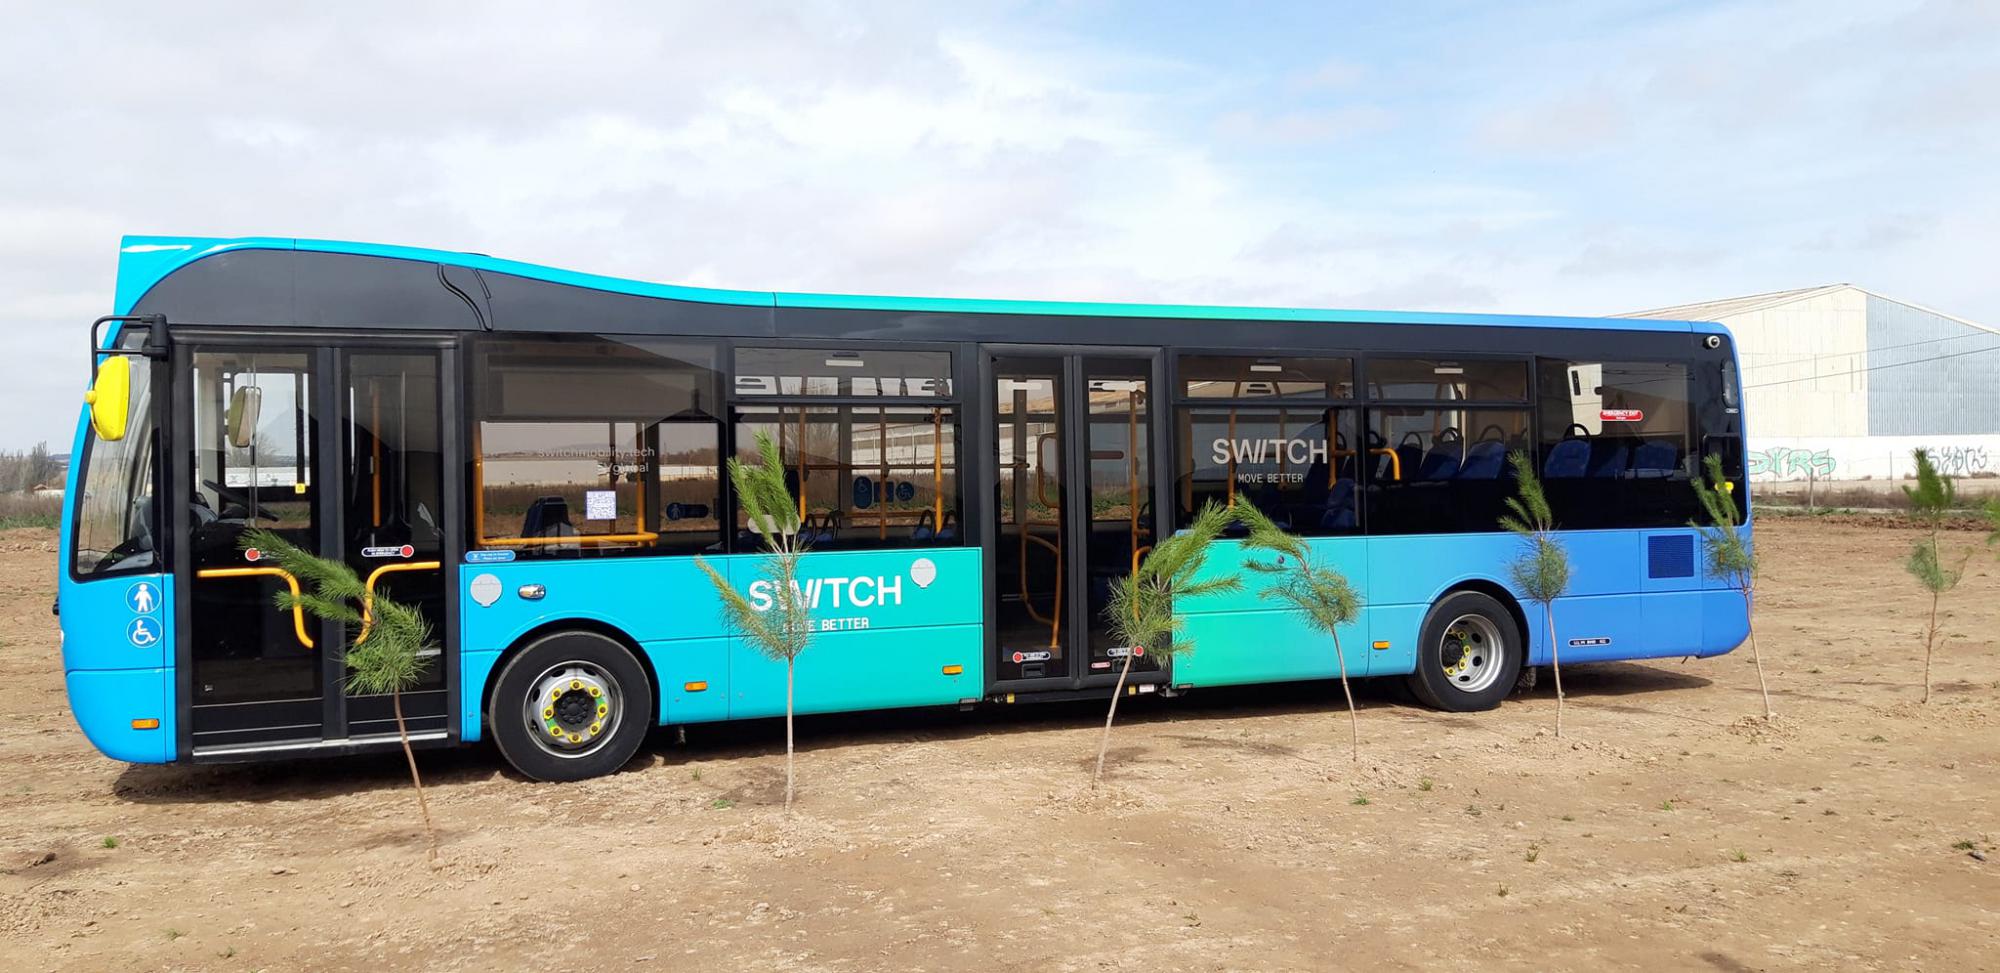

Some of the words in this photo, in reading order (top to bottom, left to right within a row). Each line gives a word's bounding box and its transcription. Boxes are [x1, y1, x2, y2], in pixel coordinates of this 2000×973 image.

[1212, 438, 1328, 464] SWITCH
[1238, 473, 1263, 483] MOVE
[1267, 473, 1304, 483] BETTER
[749, 575, 902, 612] SWITCH
[821, 617, 870, 631] BETTER
